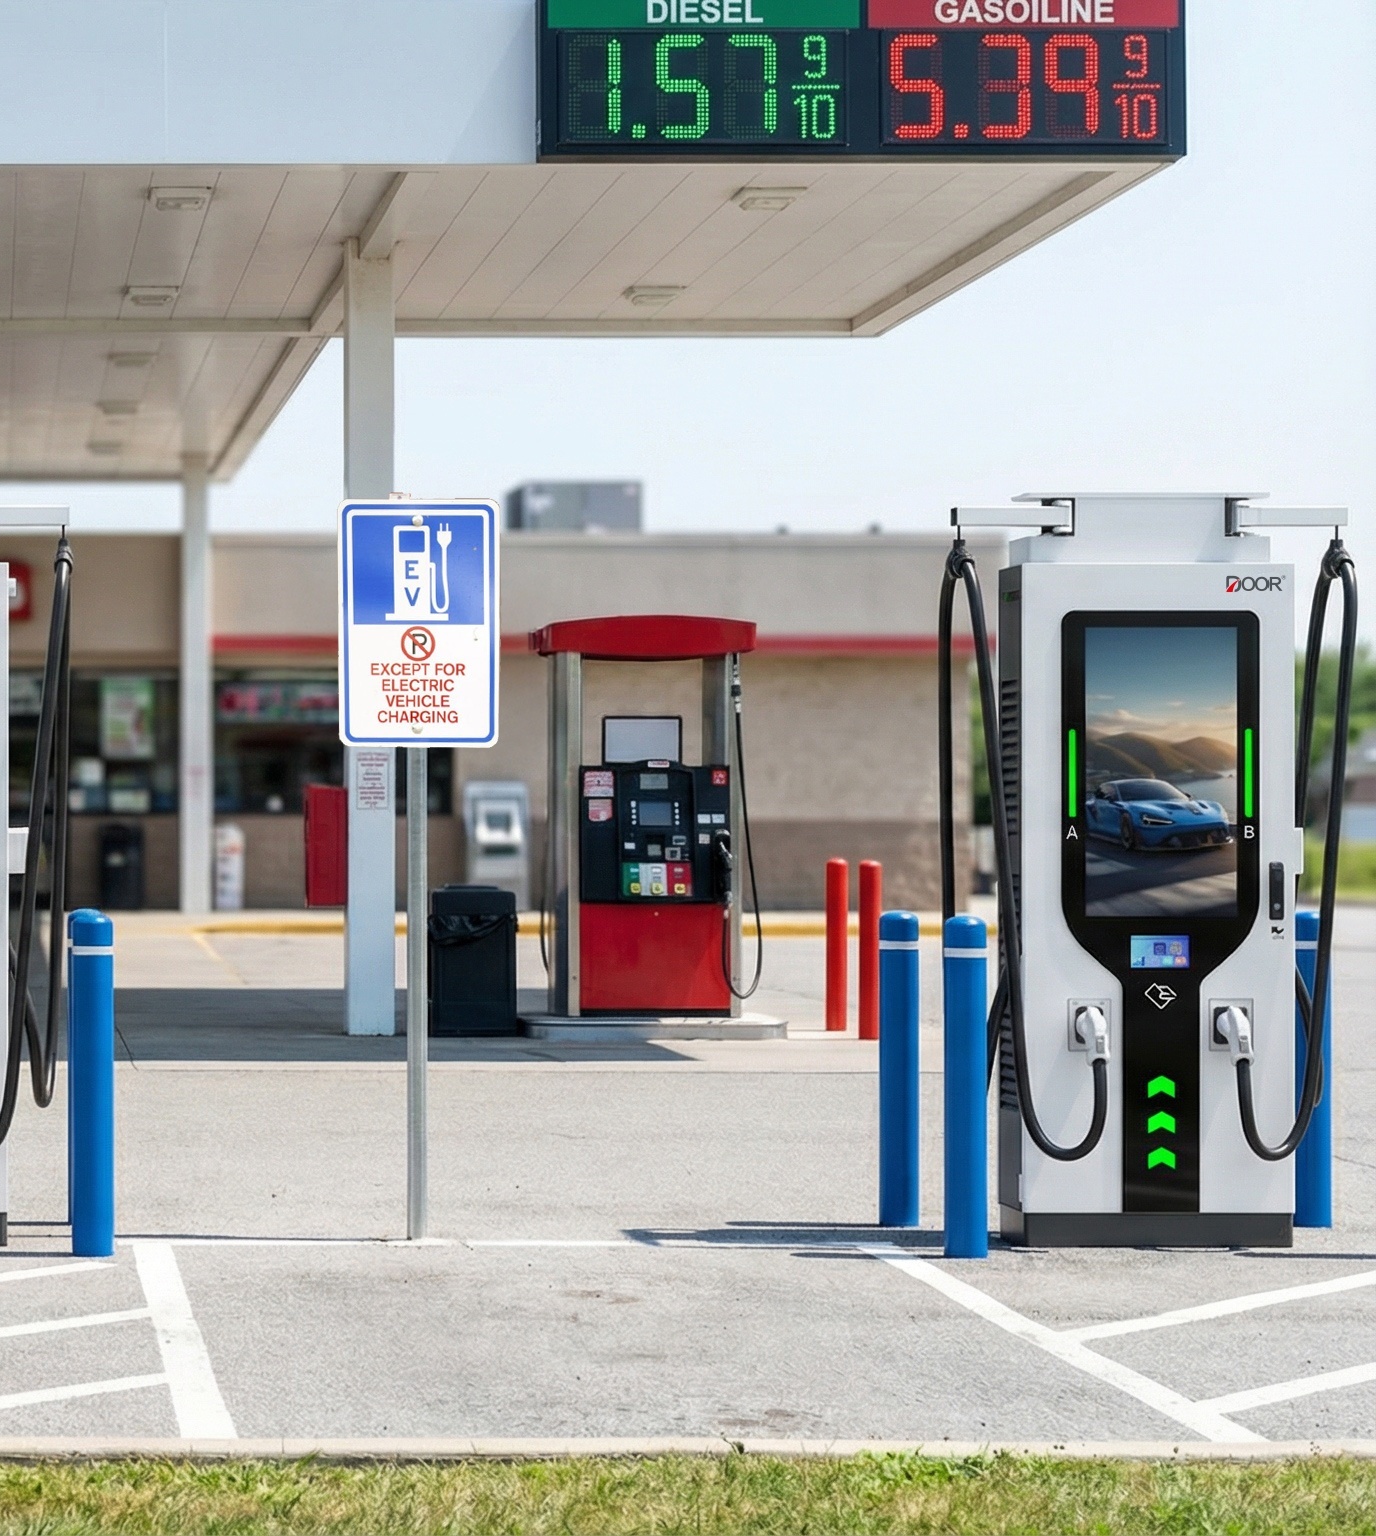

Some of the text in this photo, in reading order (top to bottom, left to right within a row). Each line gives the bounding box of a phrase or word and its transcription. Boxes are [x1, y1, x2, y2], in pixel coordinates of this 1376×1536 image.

[646, 0, 764, 24] DIESEL
[933, 0, 1115, 24] GASOILINE
[607, 34, 777, 139] 1.57
[890, 34, 1099, 139] 5.39
[370, 663, 466, 677] EXCEPT FOR
[381, 679, 455, 693] ELECTRIC
[385, 695, 450, 708] VEHICLE
[377, 710, 459, 724] CHARGING
[1066, 825, 1078, 840] A
[1243, 825, 1255, 839] B
